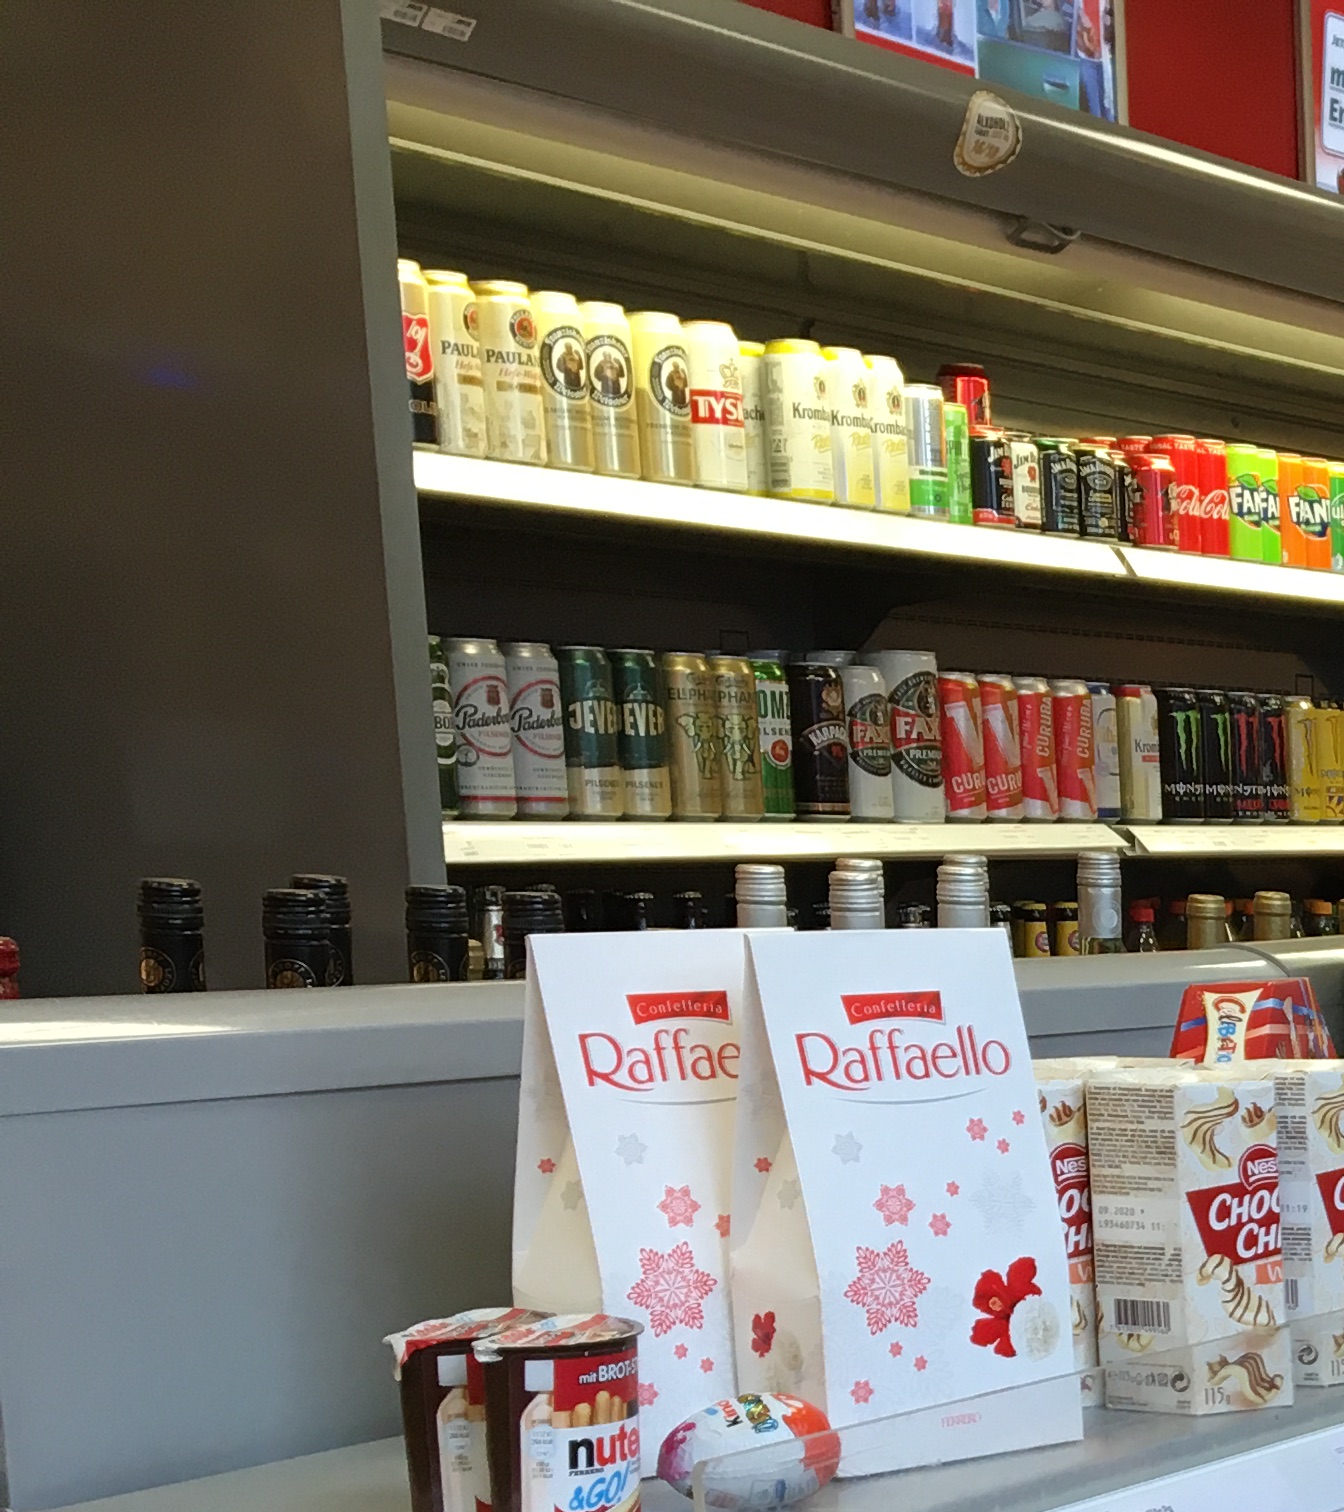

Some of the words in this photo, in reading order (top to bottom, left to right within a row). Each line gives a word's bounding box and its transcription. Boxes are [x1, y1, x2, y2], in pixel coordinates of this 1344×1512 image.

[896, 716, 942, 740] FAX
[1036, 696, 1051, 757] CURUBA
[795, 1024, 1011, 1092] Raffaello
[579, 1373, 597, 1384] mit
[1204, 1387, 1230, 1405] 115g
[940, 1413, 981, 1430] FERRERO
[569, 1460, 631, 1511] &GO!
